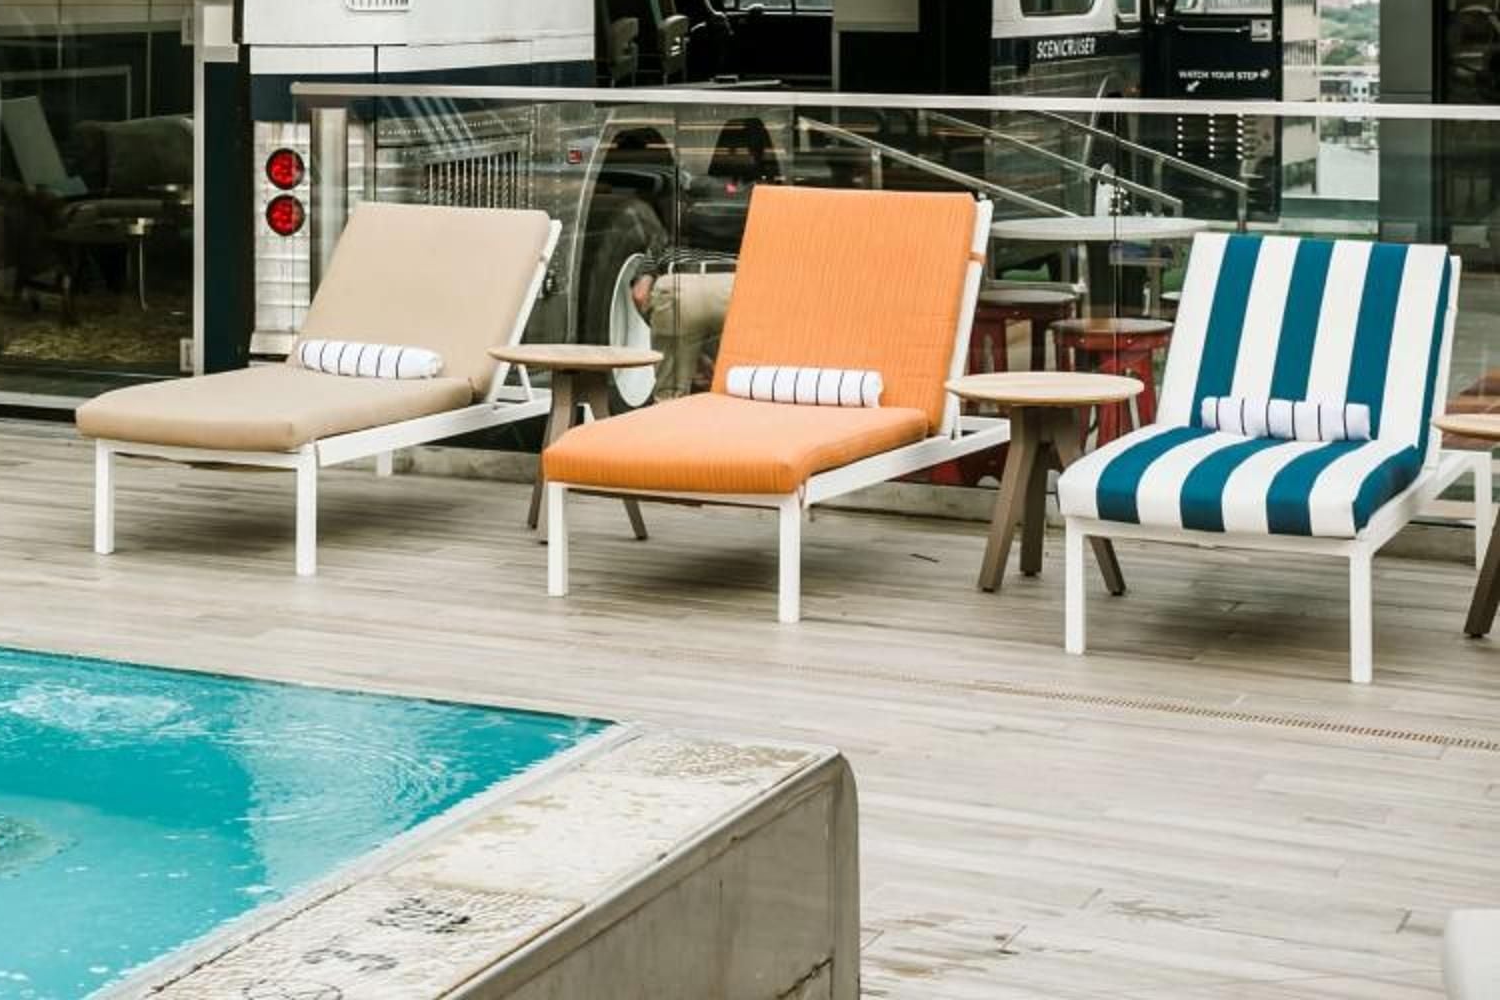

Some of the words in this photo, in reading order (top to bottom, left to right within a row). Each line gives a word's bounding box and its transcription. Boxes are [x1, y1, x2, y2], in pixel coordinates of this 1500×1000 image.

[1035, 37, 1096, 60] SCENICRUISER
[1178, 70, 1209, 79] WATCH
[1211, 70, 1235, 79] YOUR
[1237, 71, 1259, 80] STEP
